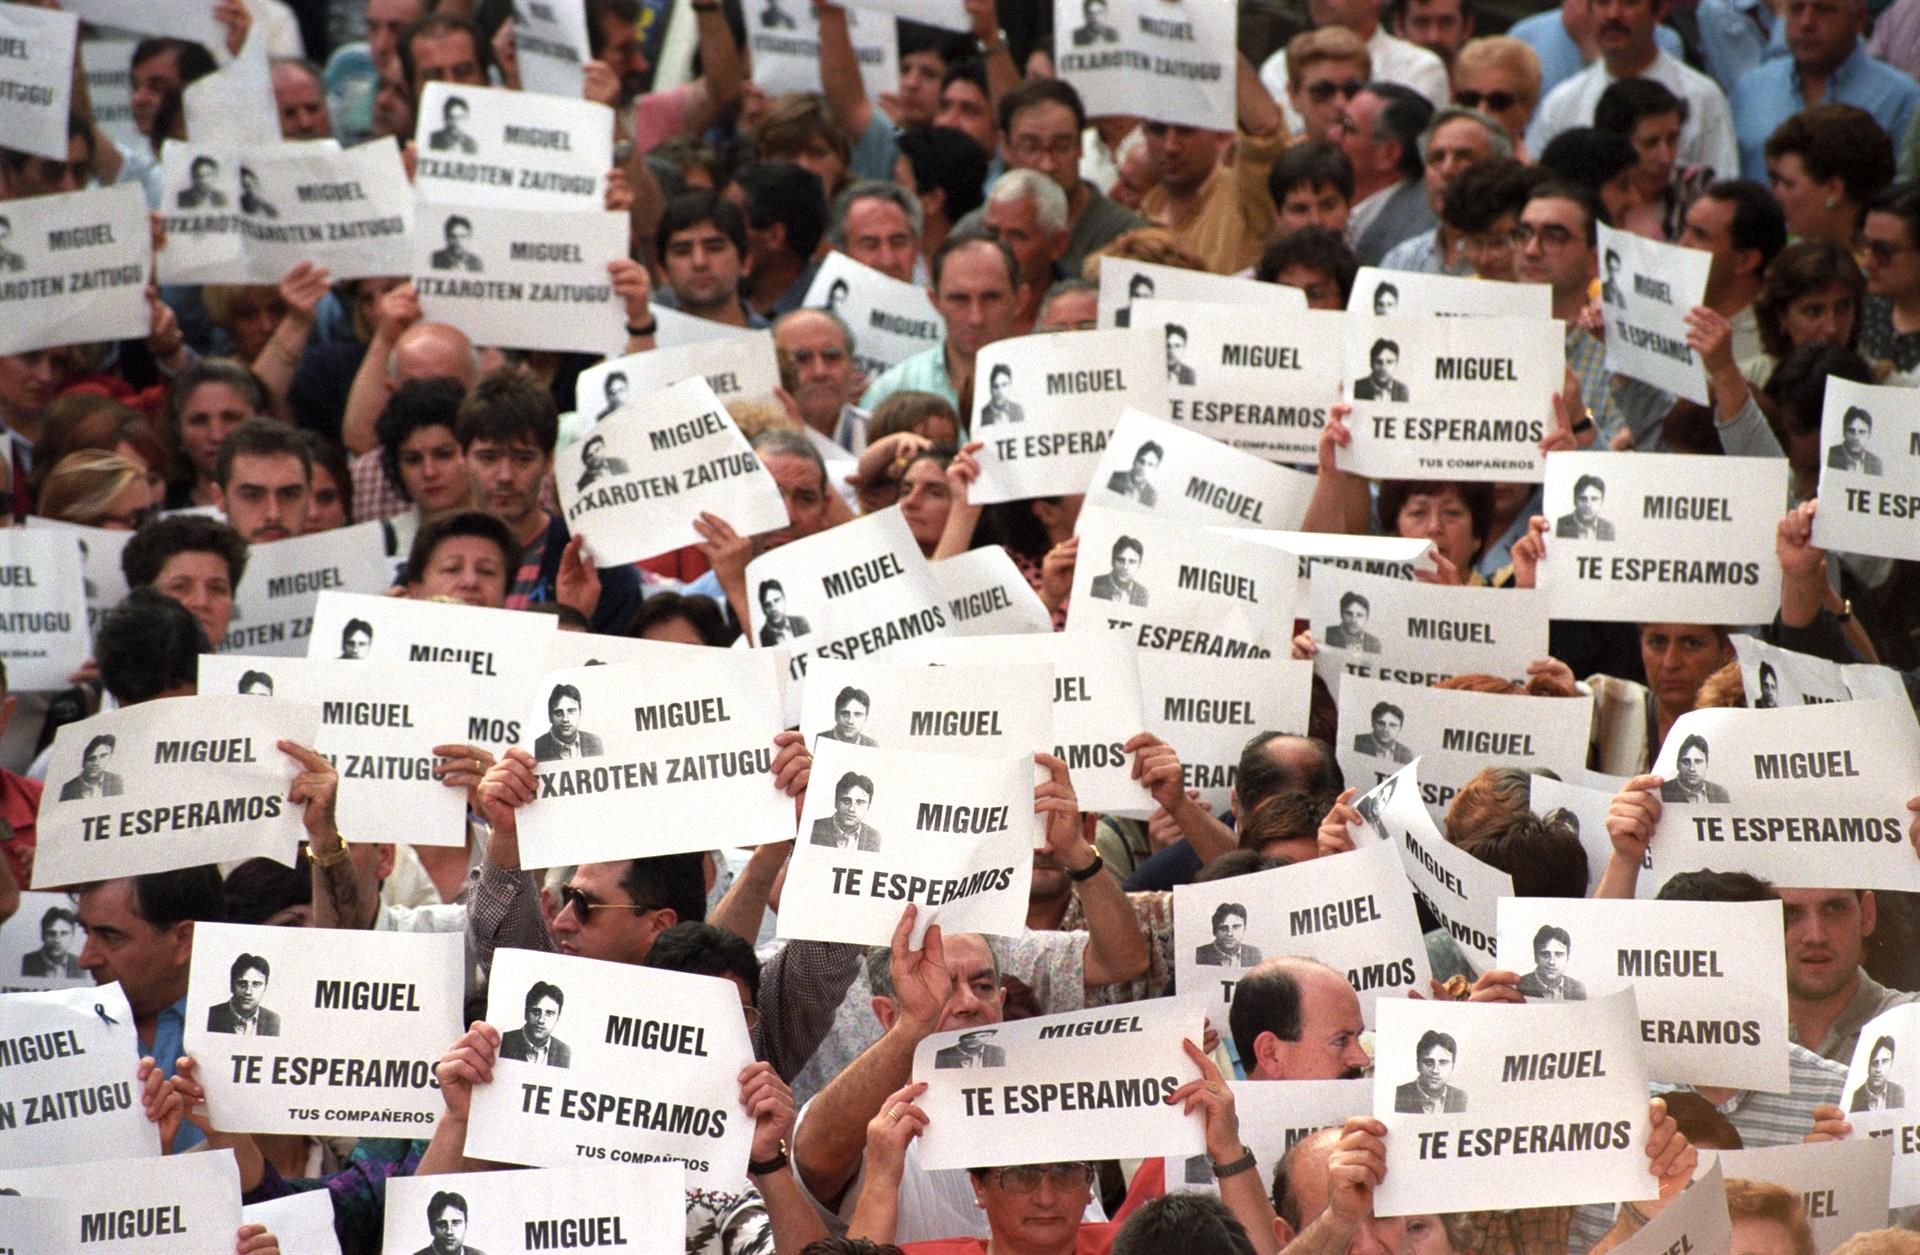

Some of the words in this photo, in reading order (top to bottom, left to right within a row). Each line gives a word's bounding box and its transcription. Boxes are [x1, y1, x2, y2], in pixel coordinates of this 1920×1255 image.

[0, 38, 28, 60] UEL
[504, 125, 571, 151] MIGUEL
[519, 170, 597, 195] ZAITUGU
[49, 224, 115, 249] MIGUEL
[510, 241, 583, 263] MIGUEL
[416, 276, 523, 300] ITXAROTEN
[529, 284, 610, 303] ZAITUGU
[869, 309, 938, 339] MIGUEL
[1222, 343, 1302, 370] MIGUEL
[1435, 357, 1518, 381] MIGUEL
[1047, 368, 1127, 395] MIGUEL
[1192, 402, 1325, 428] ESPERAMOS
[1372, 416, 1397, 438] TE
[1404, 420, 1543, 442] ESPERAMOS
[649, 410, 728, 451] MIGUEL
[997, 441, 1018, 462] TE
[1026, 430, 1113, 457] ESPERA
[1419, 459, 1443, 468] TUS
[1447, 459, 1535, 470] COMPAÑEROS
[569, 475, 679, 520] ITXAROTEN
[1185, 476, 1264, 524] MIGUEL
[1643, 496, 1733, 522] MIGUEL
[1845, 488, 1871, 513] TE
[0, 565, 37, 588] UEL
[268, 567, 344, 597] MIGUEL
[822, 552, 904, 599] MIGUEL
[1178, 564, 1258, 603] MIGUEL
[1576, 556, 1602, 579] TE
[1611, 558, 1760, 586] ESPERAMOS
[948, 585, 1013, 621] MIGUEL
[0, 612, 71, 633] AITUGU
[1407, 617, 1496, 644] MIGUEL
[323, 702, 413, 728] MIGUEL
[635, 698, 730, 731] MIGUEL
[910, 711, 1002, 736] MIGUEL
[1164, 697, 1256, 725] MIGUEL
[155, 738, 257, 765] MIGUEL
[1442, 728, 1535, 756] MIGUEL
[666, 748, 772, 784] ZAITUGU
[1754, 750, 1859, 780] MIGUEL
[82, 815, 111, 842] TE
[119, 795, 281, 838] ESPERAMOS
[916, 803, 1009, 834] MIGUEL
[1692, 817, 1725, 842] TE
[1732, 817, 1903, 843] ESPERAMOS
[1405, 830, 1468, 900] MIGUEL
[832, 867, 863, 895] TE
[870, 867, 1014, 906] ESPERAMOS
[1290, 894, 1381, 937] MIGUEL
[1617, 949, 1724, 978] MIGUEL
[315, 980, 420, 1012] MIGUEL
[605, 1014, 708, 1057] MIGUEL
[1039, 1016, 1143, 1040] MIGUEL
[1641, 1020, 1761, 1046] ERAMOS
[231, 1055, 261, 1083] TE
[1502, 1049, 1606, 1083] MIGUEL
[22, 1081, 132, 1127] ZAITUGU
[961, 1087, 995, 1116] TE
[1004, 1076, 1179, 1114] ESPERAMOS
[289, 1109, 319, 1121] TUS
[325, 1108, 434, 1124] COMPAÑEROS
[521, 1083, 551, 1115] TE
[560, 1089, 728, 1139] ESPERAMOS
[575, 1144, 606, 1159] TUS
[1418, 1131, 1447, 1160] TE
[1457, 1120, 1631, 1158] ESPERAMOS
[80, 1205, 187, 1243] MIGUEL
[525, 1216, 627, 1250] MIGUEL
